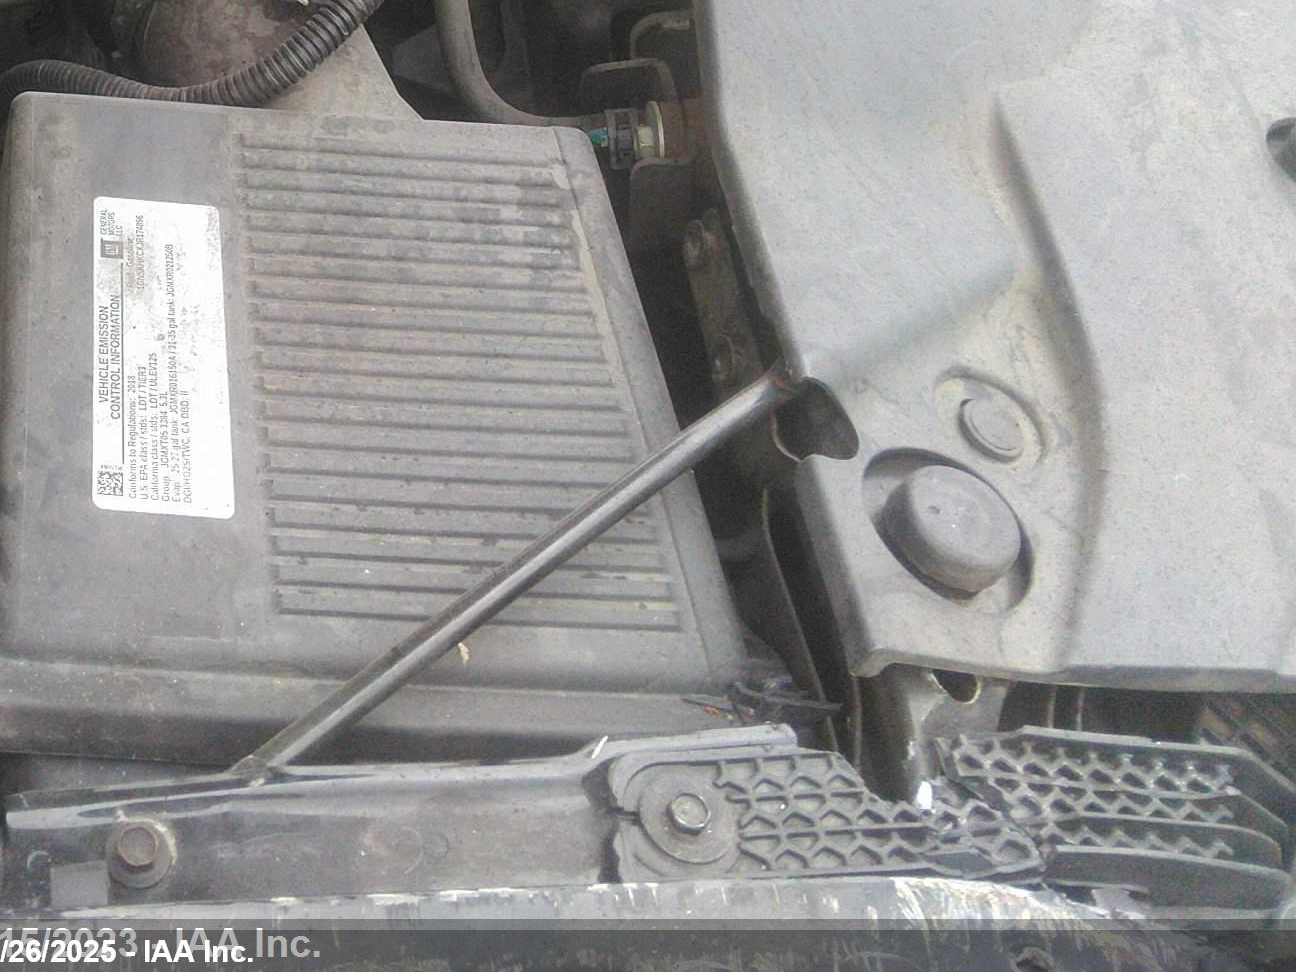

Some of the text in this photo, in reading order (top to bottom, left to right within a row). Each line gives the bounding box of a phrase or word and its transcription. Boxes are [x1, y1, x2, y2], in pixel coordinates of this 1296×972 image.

[166, 317, 178, 329] gal
[167, 329, 176, 349] 31-35
[98, 306, 109, 404] VEHICLE EMISSION
[109, 294, 121, 420] CONTROL INFORMATION
[137, 366, 146, 388] TIER3
[148, 352, 158, 386] ULEV125
[127, 375, 136, 394] 2018
[137, 396, 147, 411] LDT
[148, 393, 158, 409] LDT
[159, 391, 168, 407] 5.3L
[180, 421, 190, 434] CA
[128, 449, 137, 457] to
[138, 441, 148, 463] class
[149, 438, 158, 460] class
[169, 437, 181, 451] gal
[128, 459, 137, 499] Conforms
[138, 464, 148, 481] EPA
[149, 461, 159, 501] California
